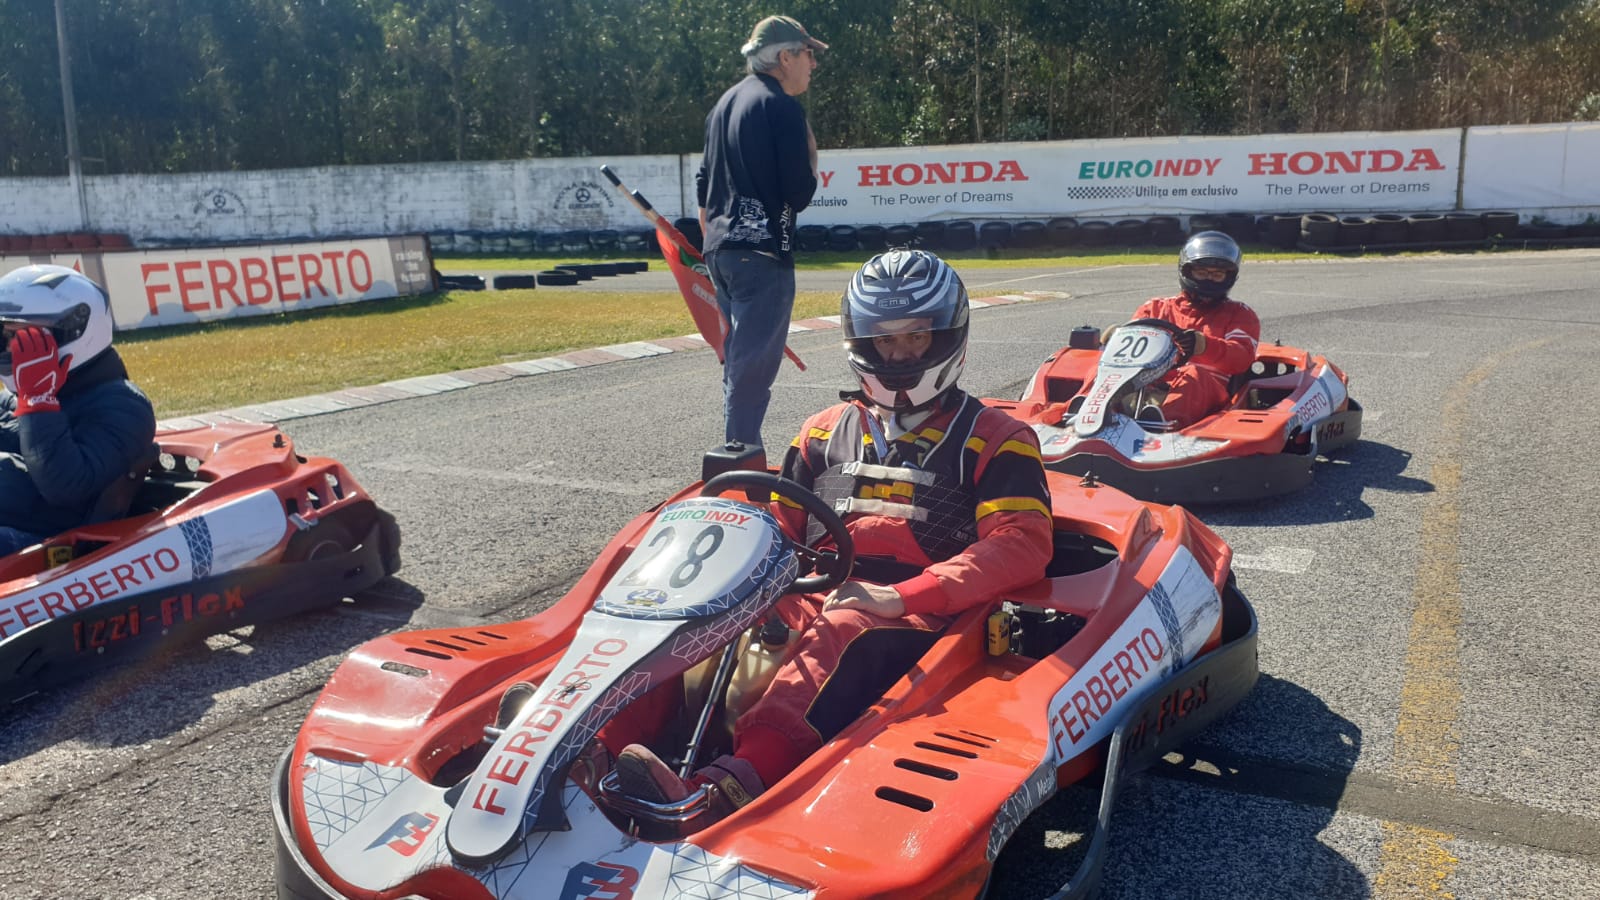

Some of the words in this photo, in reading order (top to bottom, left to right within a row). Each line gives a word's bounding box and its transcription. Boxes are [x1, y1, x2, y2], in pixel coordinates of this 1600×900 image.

[857, 160, 1029, 187] HONDA
[1078, 158, 1222, 180] EUROINDY
[1247, 148, 1446, 176] HONDA
[871, 194, 895, 206] The
[900, 193, 941, 205] Power
[944, 191, 957, 204] of
[961, 190, 1014, 203] Dreams
[1171, 187, 1188, 197] em
[1190, 184, 1238, 197] exclusivo
[1265, 183, 1293, 196] The
[1298, 183, 1345, 196] Power
[1370, 181, 1431, 194] Dreams
[140, 248, 374, 316] FERBERTO
[1113, 335, 1149, 359] 20
[661, 509, 752, 526] EUROINDY
[617, 525, 725, 589] 28
[0, 547, 181, 639] FERBERTO
[1051, 627, 1164, 760] FERBERTO
[472, 638, 628, 816] FERBERTO
